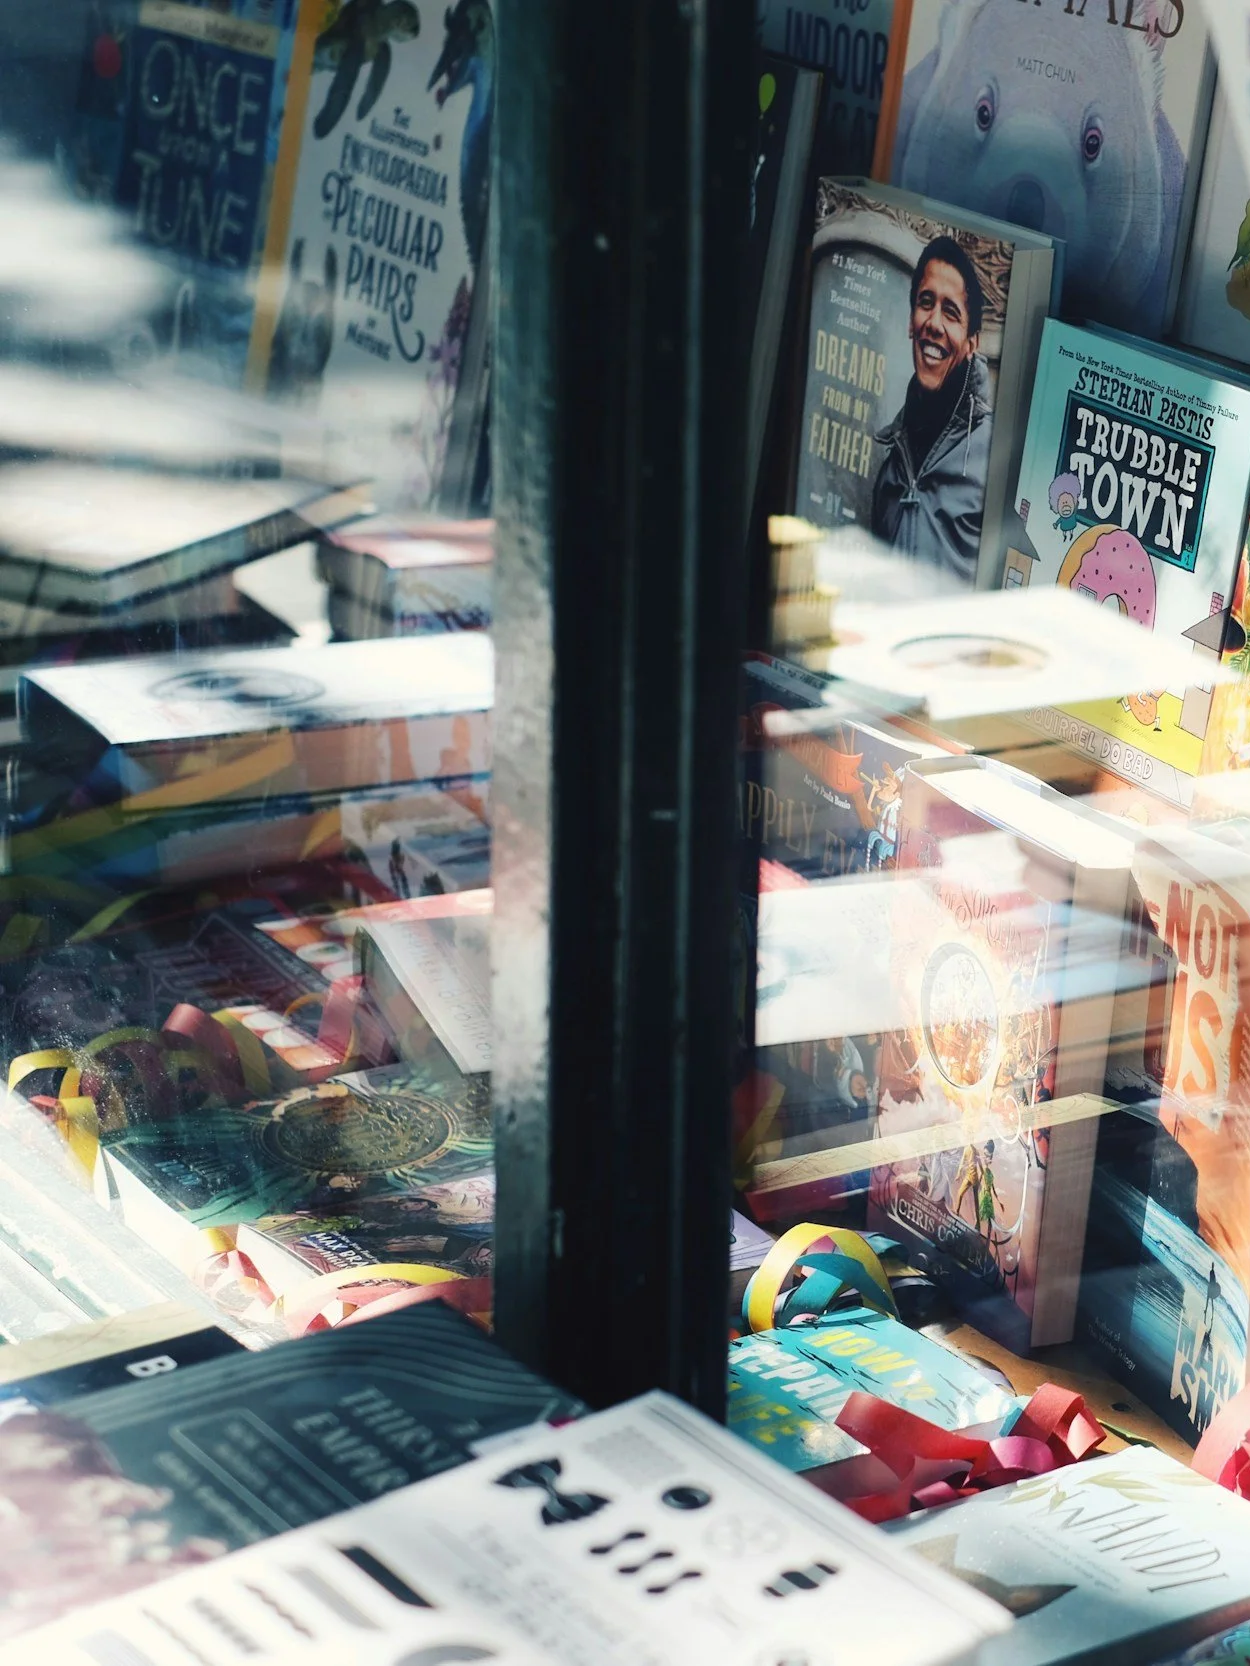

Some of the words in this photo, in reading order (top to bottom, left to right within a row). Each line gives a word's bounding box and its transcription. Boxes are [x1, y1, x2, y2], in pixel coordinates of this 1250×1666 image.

[785, 8, 889, 99] INDOOR
[1016, 56, 1044, 77] MATT
[1044, 63, 1076, 85] CHUN
[141, 39, 265, 156] ONCE
[131, 150, 249, 267] TUNE
[321, 170, 444, 273] PECULIAR
[844, 256, 865, 275] New
[866, 264, 887, 284] York
[844, 275, 872, 297] Times
[831, 289, 881, 323] Bestselling
[837, 311, 871, 335] Author
[815, 328, 887, 398] DREAMS
[1058, 345, 1076, 361] From
[1076, 350, 1086, 363] the
[1087, 356, 1100, 368] New
[1100, 361, 1115, 375] York
[1115, 366, 1133, 381] Times
[1133, 372, 1166, 394] Bestselling
[1166, 384, 1187, 402] Author
[1187, 391, 1196, 405] of
[1196, 395, 1217, 415] Timmy
[823, 385, 850, 418] FROM
[853, 395, 871, 424] MY
[1074, 366, 1155, 417] STEPHAN
[1157, 397, 1215, 440] PASTIS
[809, 411, 875, 479] FATHER
[1076, 407, 1202, 493] TRUBBLE
[1069, 452, 1194, 556] TOWN
[1025, 706, 1096, 753] SQUIRREL
[1100, 737, 1121, 765] DO
[1123, 749, 1154, 780] BAD
[1128, 897, 1161, 960] IF
[1164, 879, 1240, 995] NOT
[1143, 953, 1224, 1100] US
[310, 1232, 349, 1252] MAX
[898, 1198, 935, 1234] CHRIS
[802, 1328, 918, 1374] HOW
